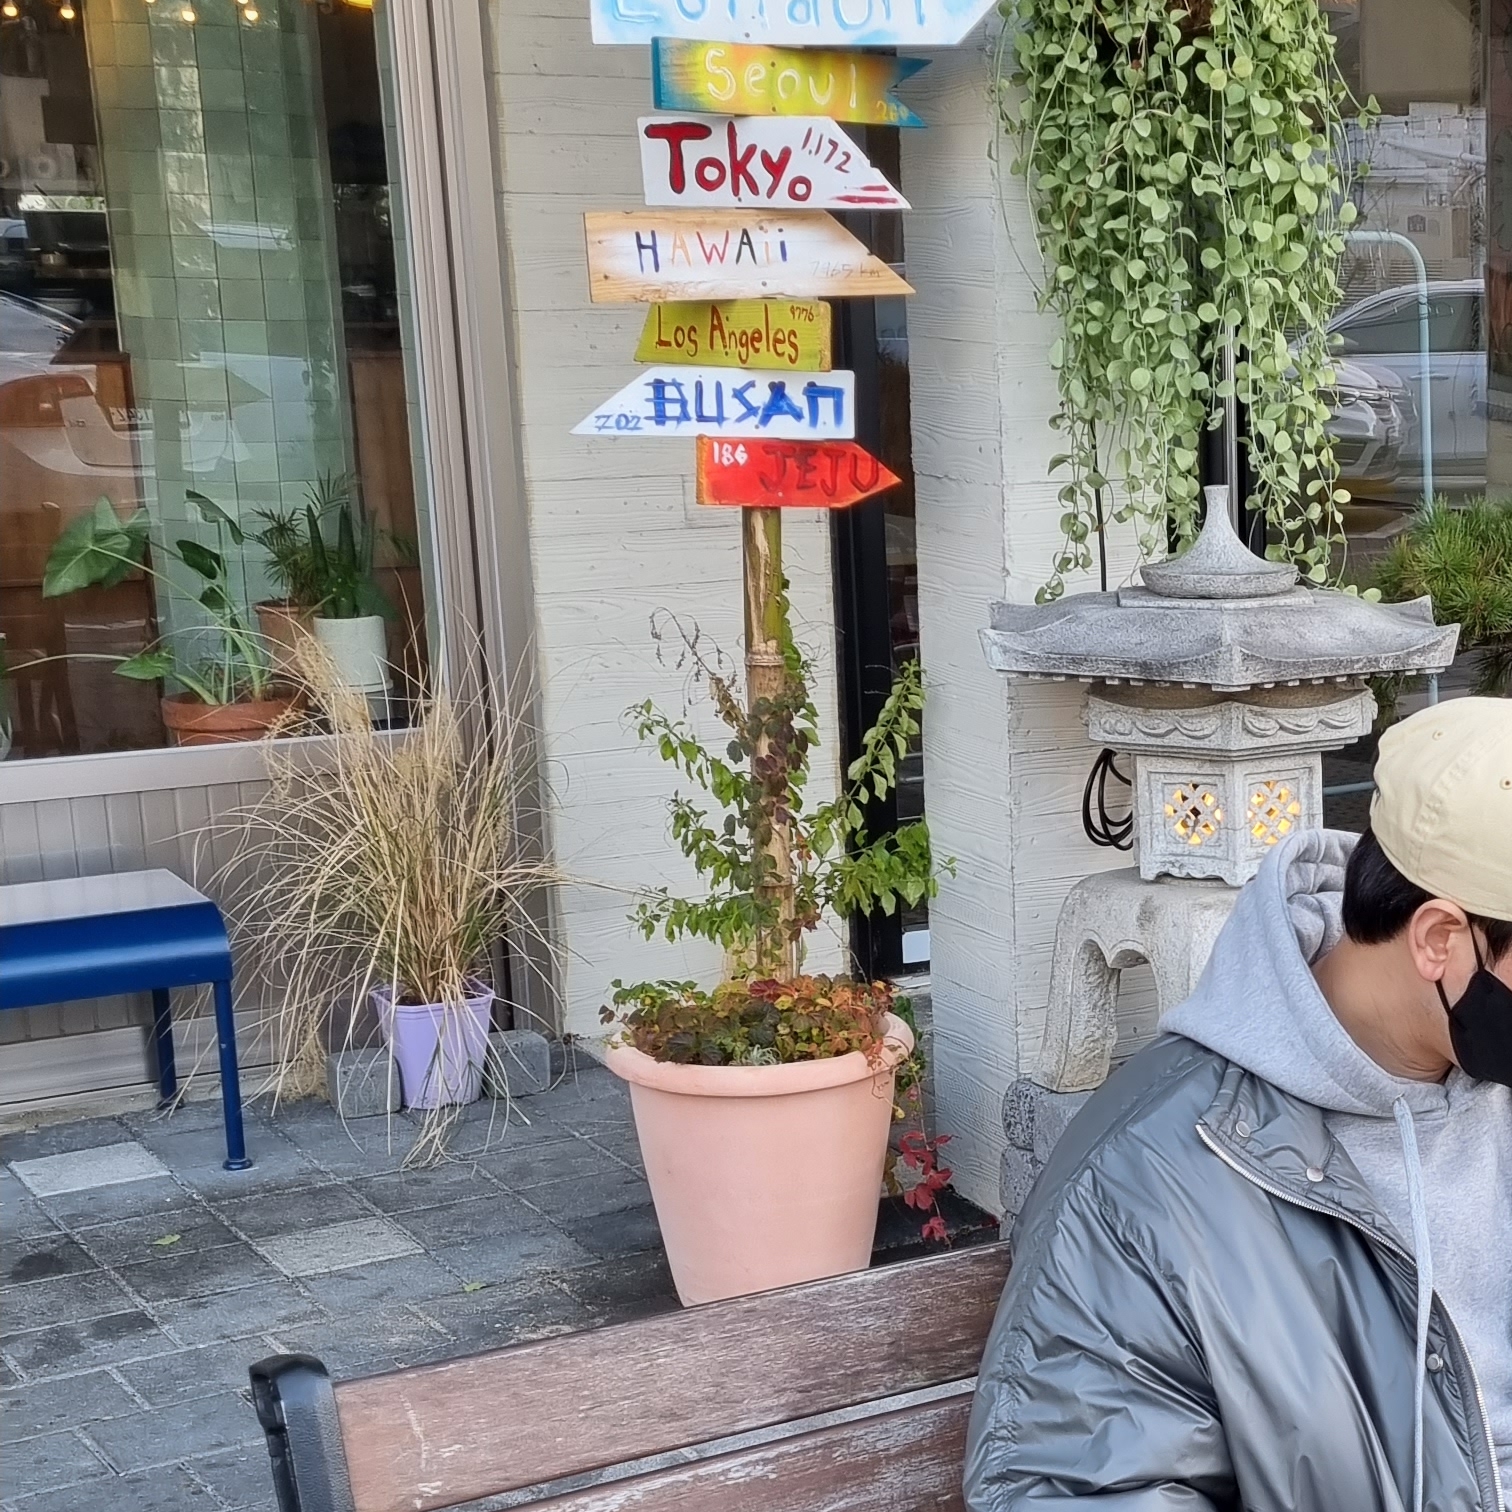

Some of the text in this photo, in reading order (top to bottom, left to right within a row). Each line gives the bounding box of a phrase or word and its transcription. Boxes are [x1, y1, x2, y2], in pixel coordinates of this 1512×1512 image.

[705, 49, 858, 109] Seoul
[644, 121, 813, 202] Tokyo
[656, 304, 799, 365] Los Angeles
[712, 441, 748, 467] 186
[759, 444, 880, 497] JEJU
